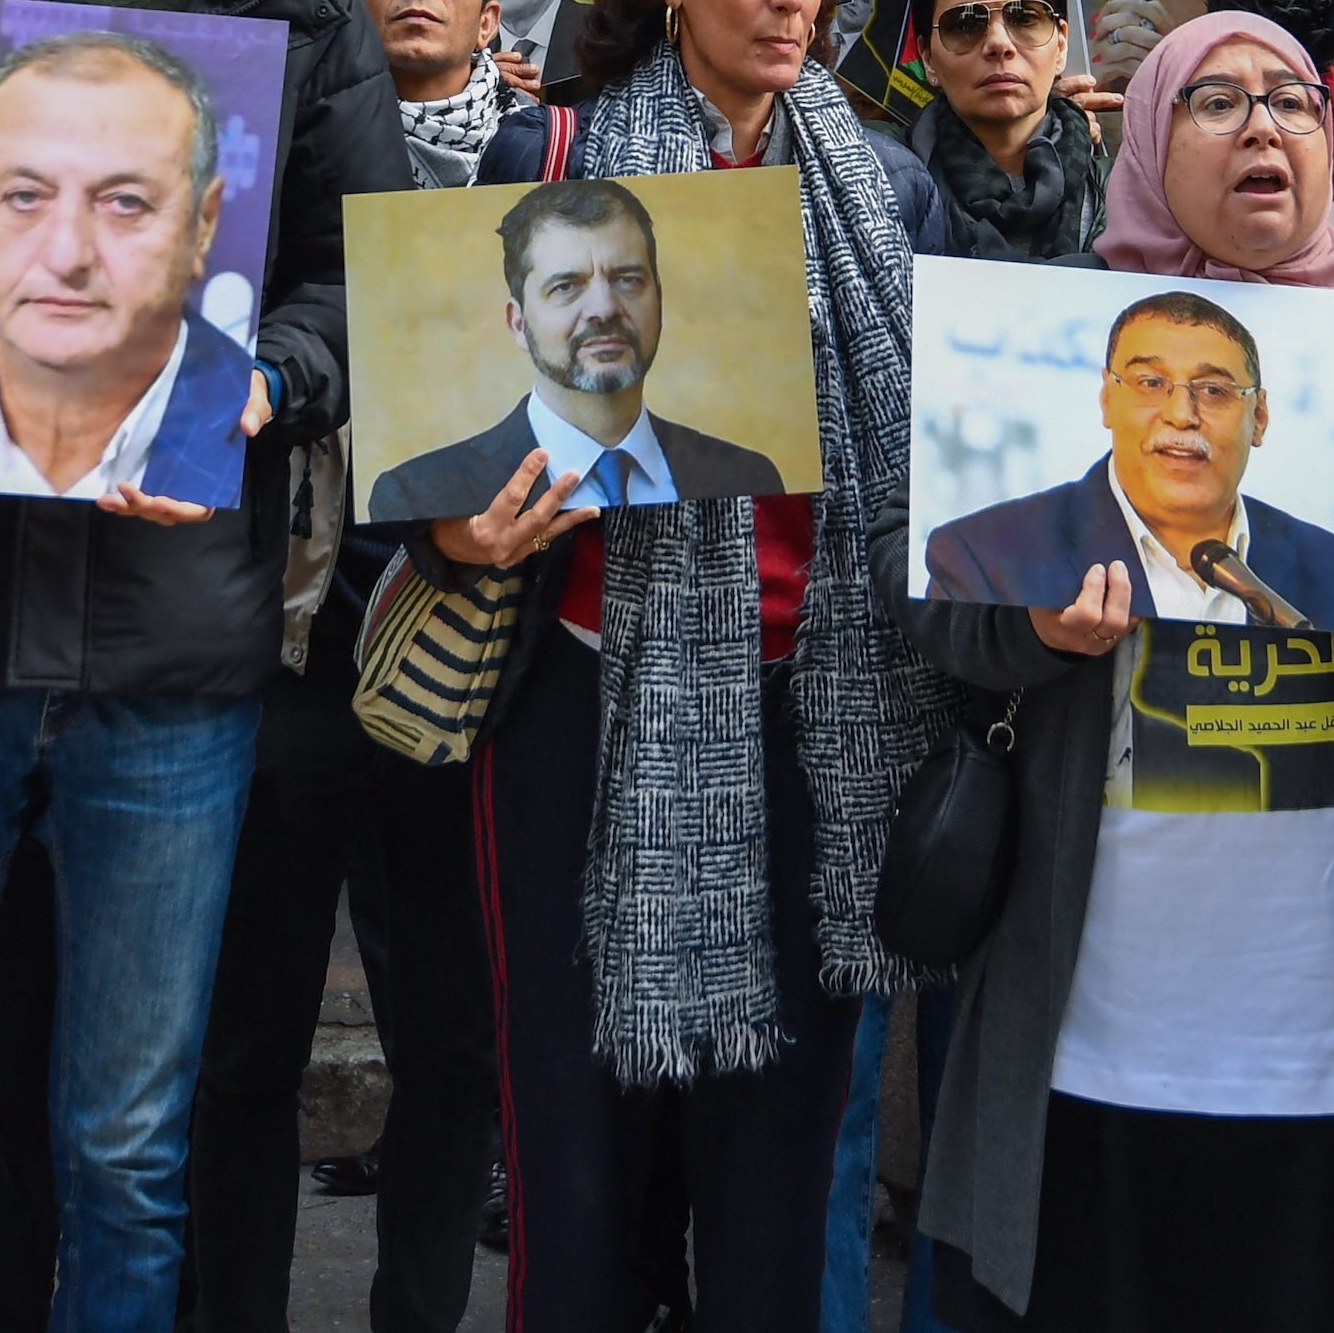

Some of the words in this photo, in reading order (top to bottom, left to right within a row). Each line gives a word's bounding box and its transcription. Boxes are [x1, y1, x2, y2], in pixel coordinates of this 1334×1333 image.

[1189, 718, 1243, 736] الجلاصي
[1247, 718, 1290, 735] الحميد
[1295, 719, 1317, 733] عبد
